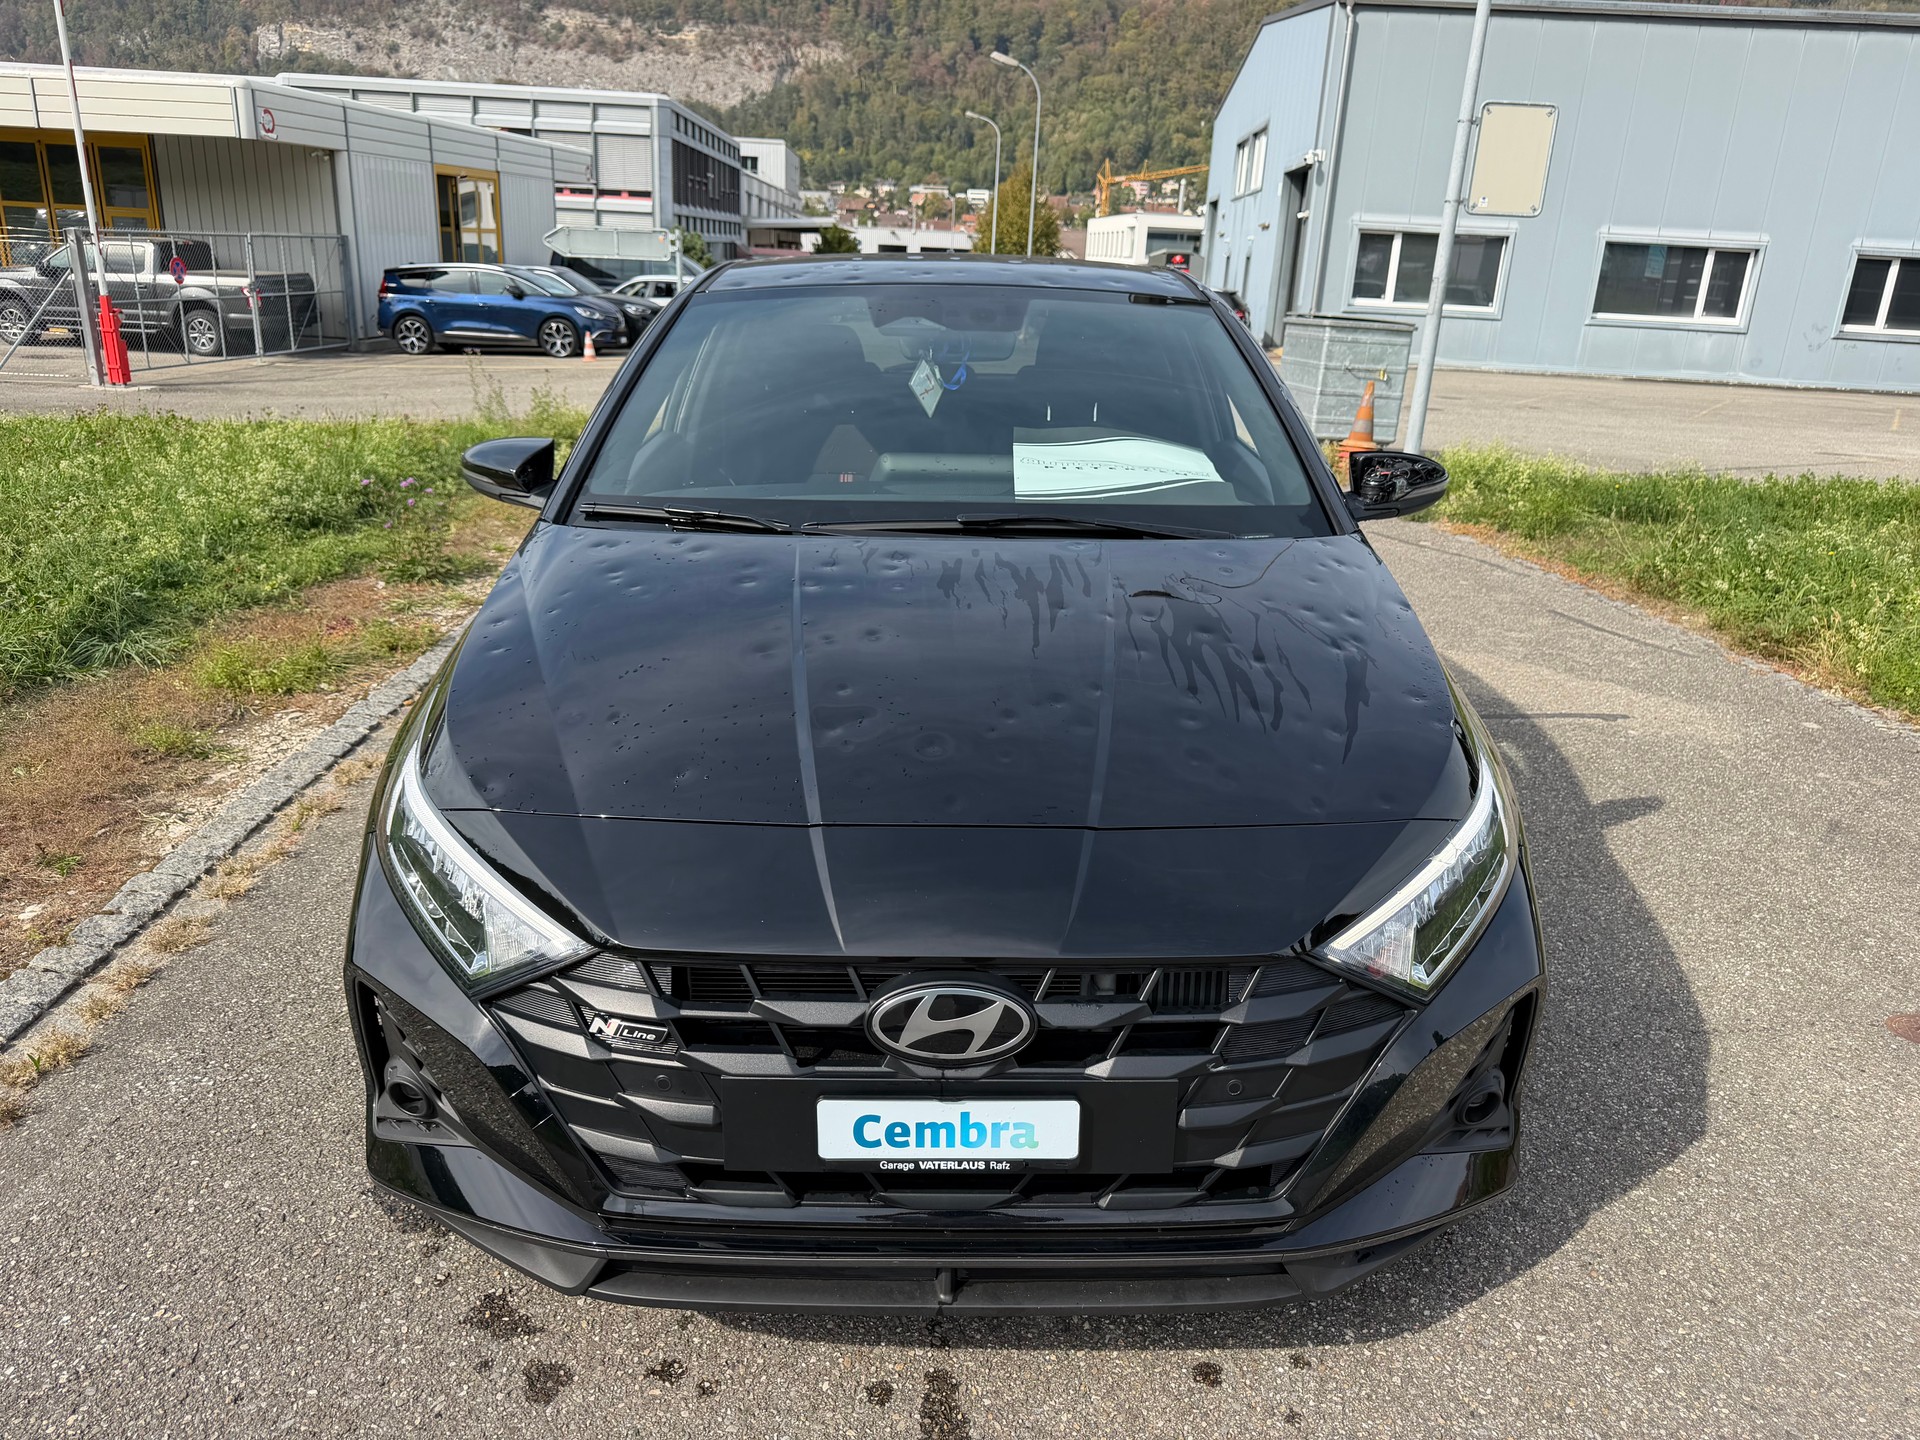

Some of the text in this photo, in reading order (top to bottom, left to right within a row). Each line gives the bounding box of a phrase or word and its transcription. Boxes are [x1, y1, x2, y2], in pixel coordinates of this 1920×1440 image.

[588, 1017, 656, 1041] N Line
[852, 1111, 1039, 1149] Cembra
[879, 1160, 1010, 1172] Garage VATERLAUS Rafz
